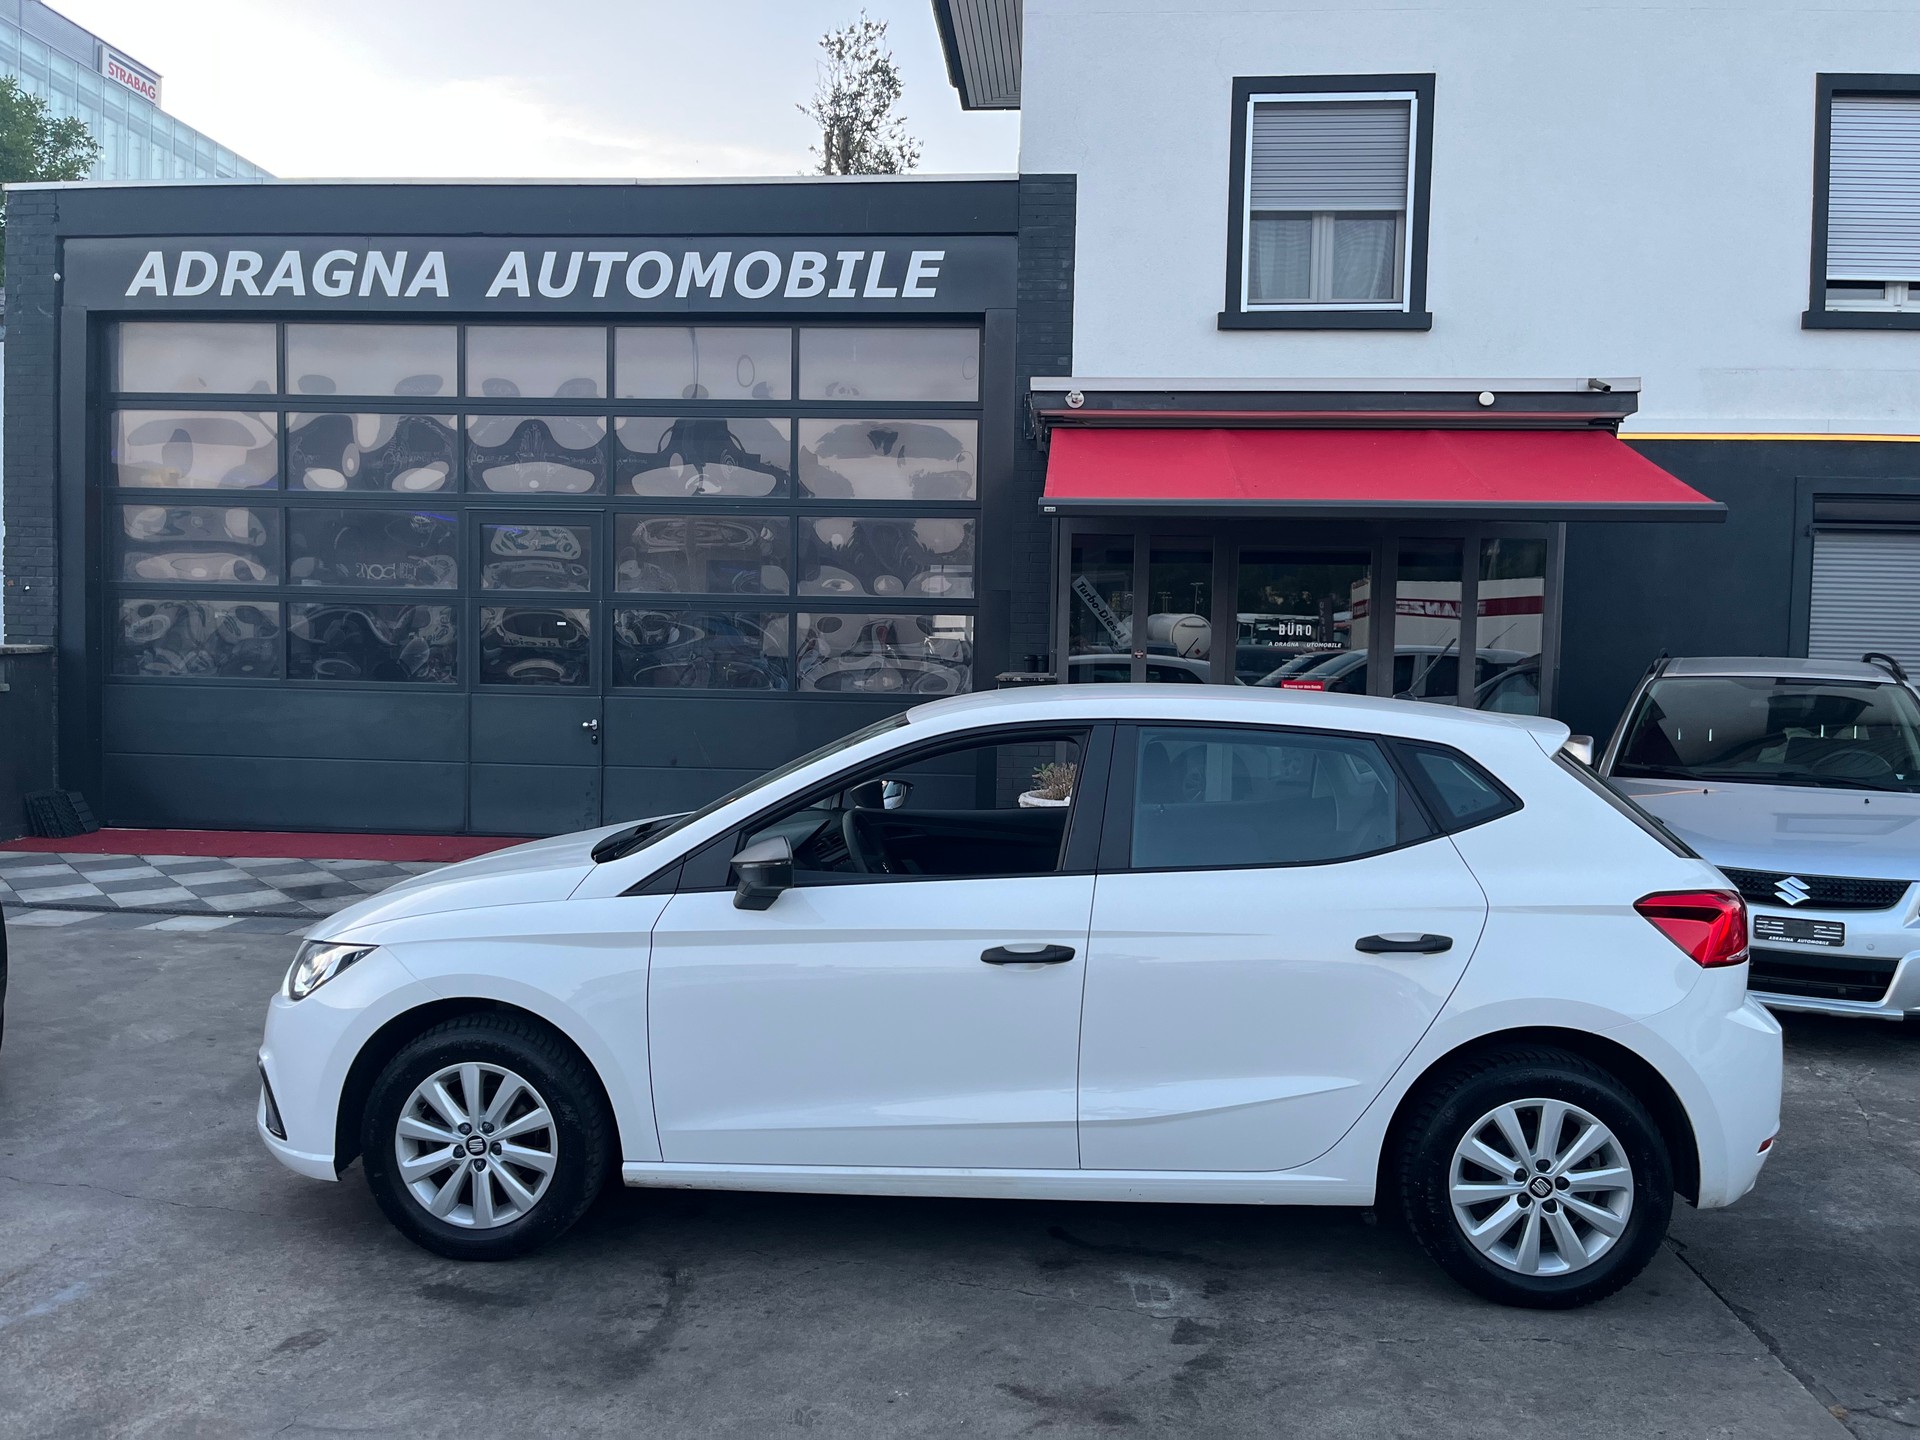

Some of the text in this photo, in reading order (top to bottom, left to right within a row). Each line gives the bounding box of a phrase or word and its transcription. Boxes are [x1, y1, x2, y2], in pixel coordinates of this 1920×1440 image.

[108, 61, 156, 100] STRABAG
[125, 250, 945, 298] ADRAGNA AUTOMOBILE
[1077, 581, 1126, 639] Turbo-Diesel
[1278, 622, 1312, 636] BÜRO
